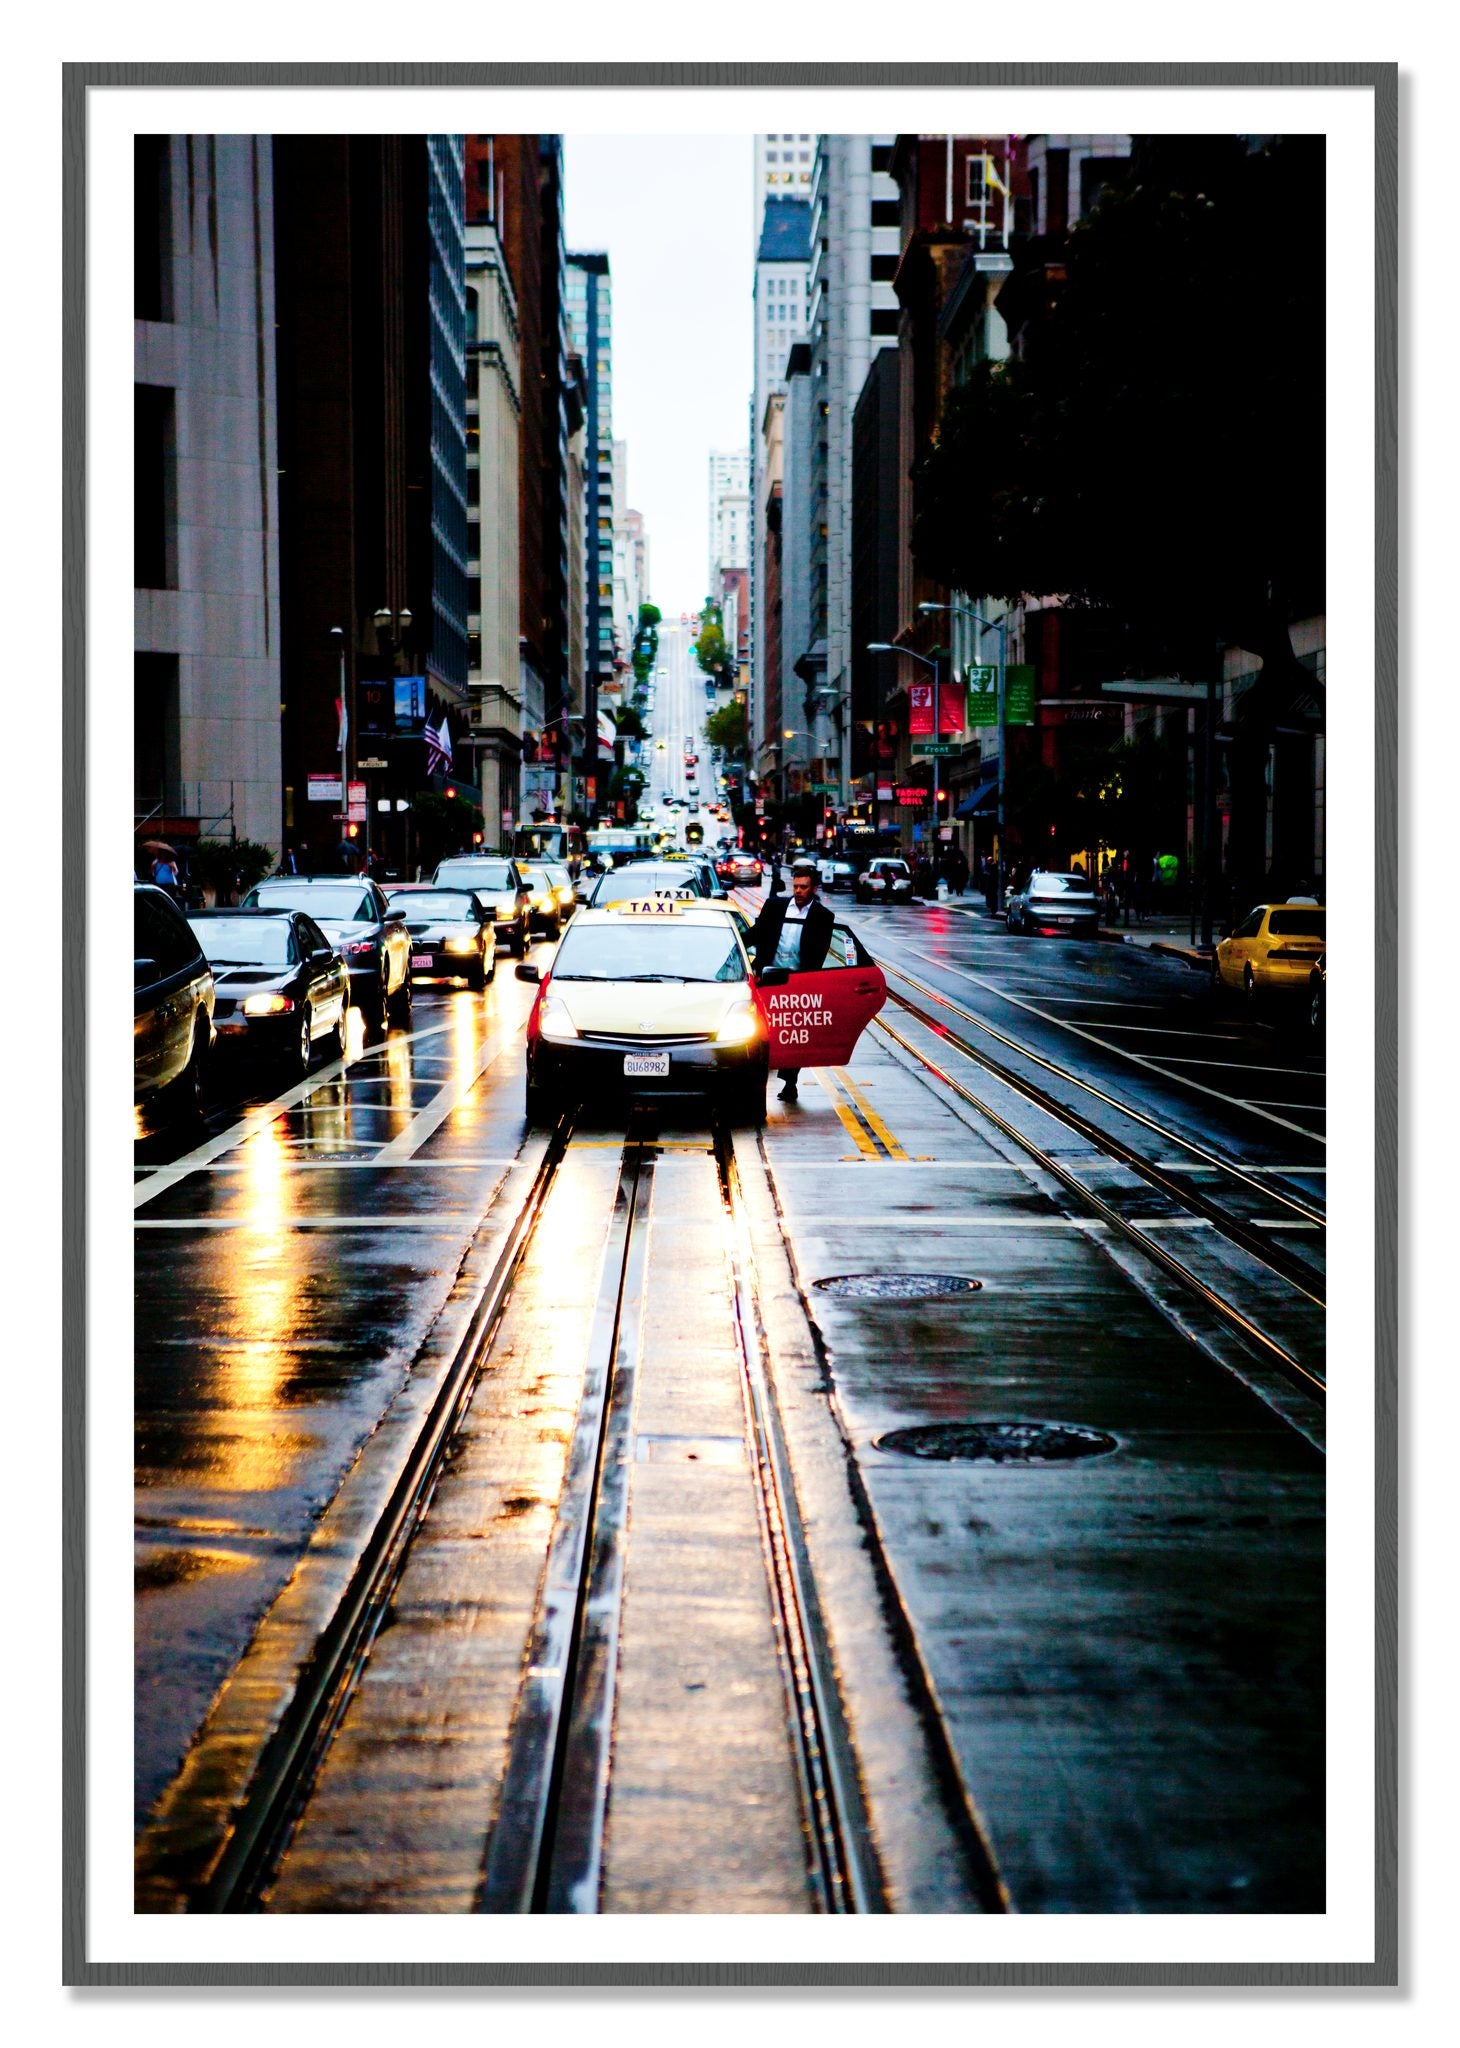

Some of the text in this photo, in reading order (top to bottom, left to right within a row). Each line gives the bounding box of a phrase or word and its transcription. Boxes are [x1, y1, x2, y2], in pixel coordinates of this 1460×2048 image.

[366, 691, 381, 704] 10
[924, 745, 949, 753] Front
[895, 788, 928, 797] TADICH
[899, 797, 923, 805] GRILL
[655, 890, 690, 899] TAXI
[630, 902, 673, 913] TAXI
[769, 993, 823, 1009] ARROW
[778, 1029, 809, 1045] CAB
[627, 1061, 666, 1073] 8U68982
